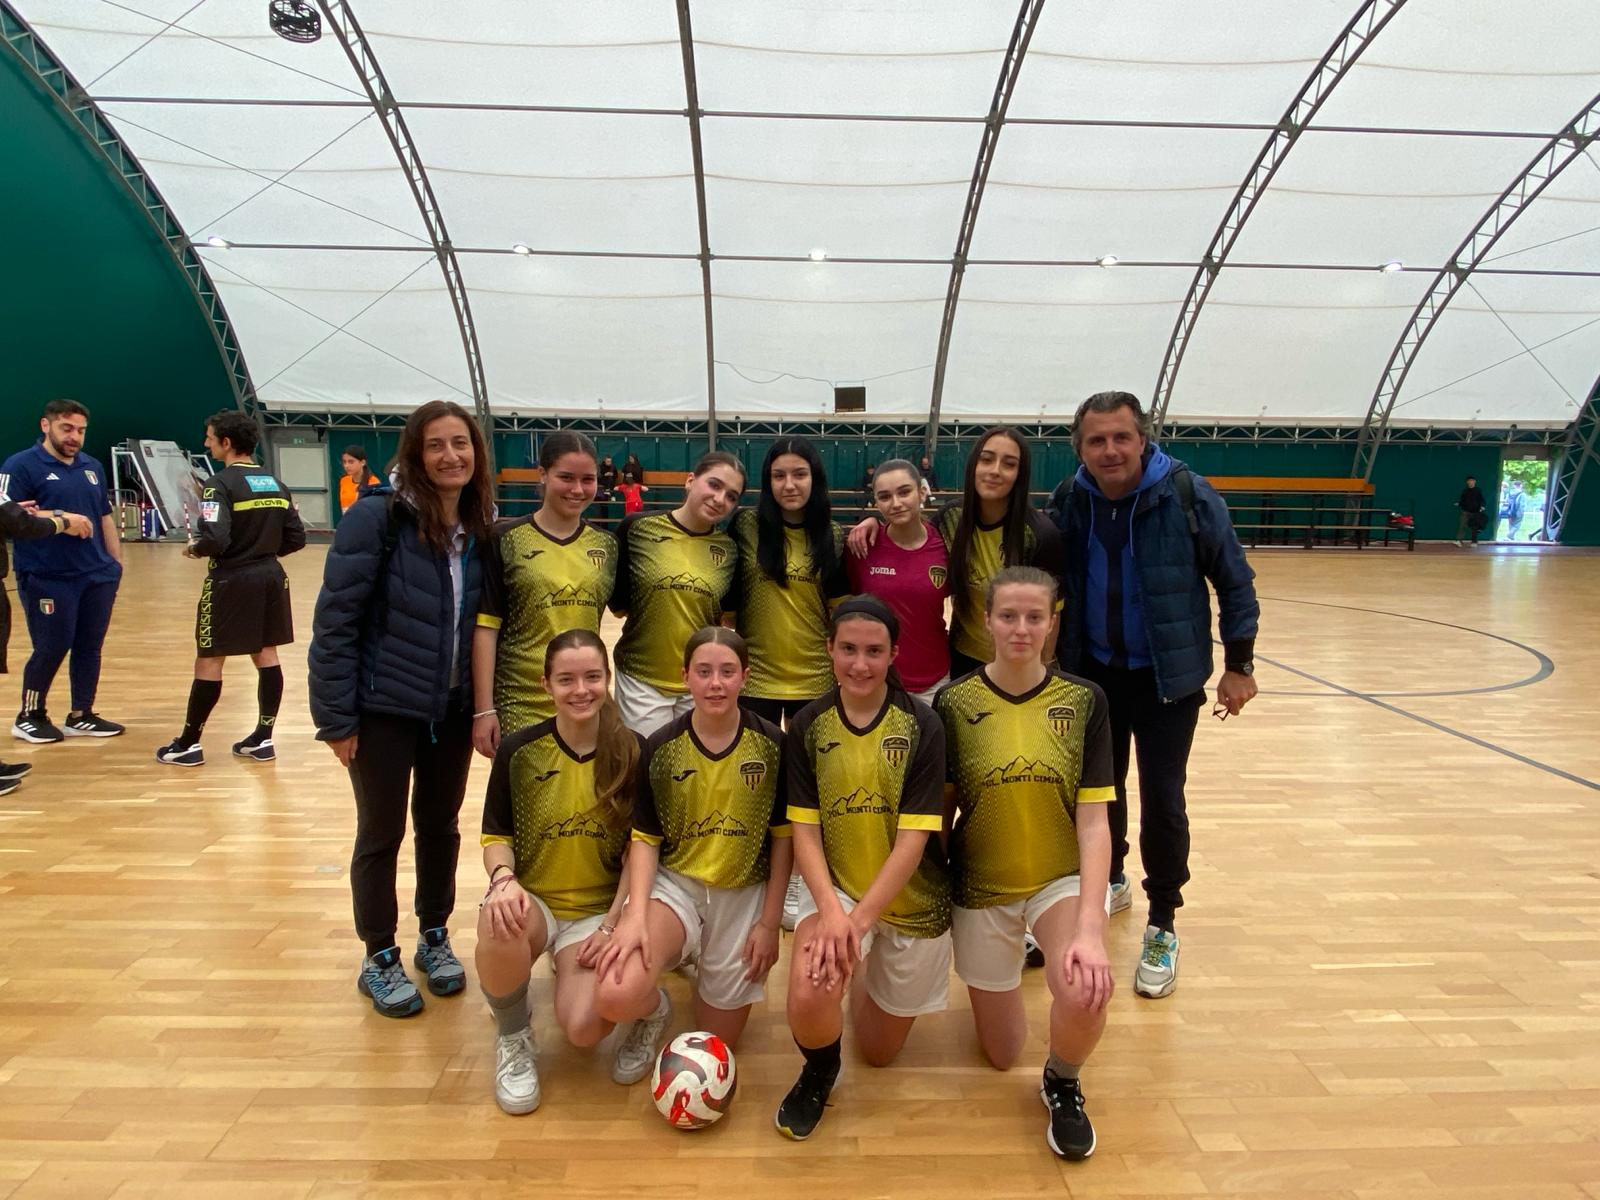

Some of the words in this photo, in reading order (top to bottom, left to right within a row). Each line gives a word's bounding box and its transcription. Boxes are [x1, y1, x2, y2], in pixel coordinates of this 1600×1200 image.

[669, 583, 693, 591] MONTI
[551, 599, 576, 607] MONTI
[1001, 774, 1031, 784] MONTI
[846, 805, 872, 814] MONTI
[558, 828, 583, 838] MONTI
[697, 827, 722, 838] MONTI
